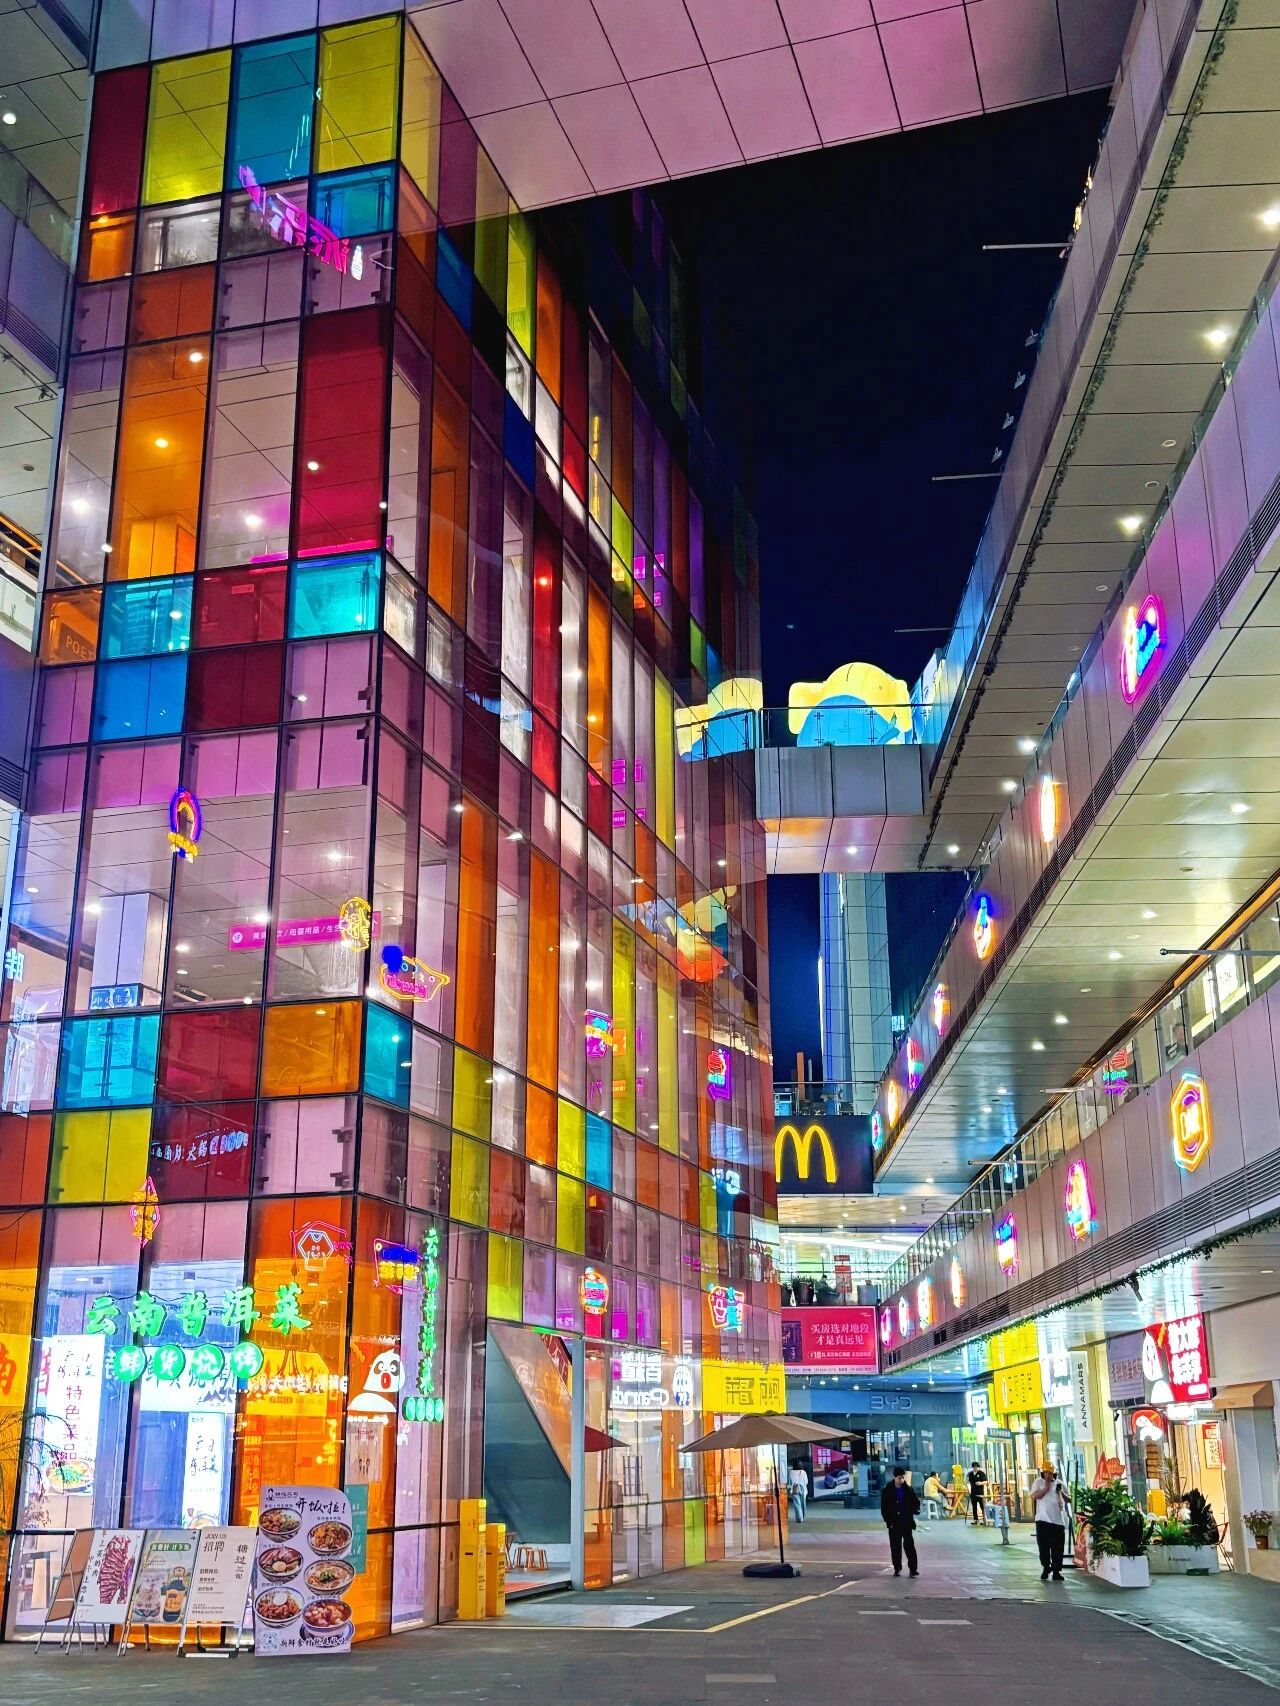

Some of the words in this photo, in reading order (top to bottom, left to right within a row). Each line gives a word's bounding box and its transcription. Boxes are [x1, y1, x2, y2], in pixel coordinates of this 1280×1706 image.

[86, 1281, 312, 1337] 云南普洱菜
[810, 1323, 870, 1334] 买房选对地段
[816, 1334, 865, 1346] 才是真远见
[870, 1395, 913, 1411] BYD
[1077, 1363, 1088, 1429] ANNAMARS
[203, 1541, 225, 1561] 招聘
